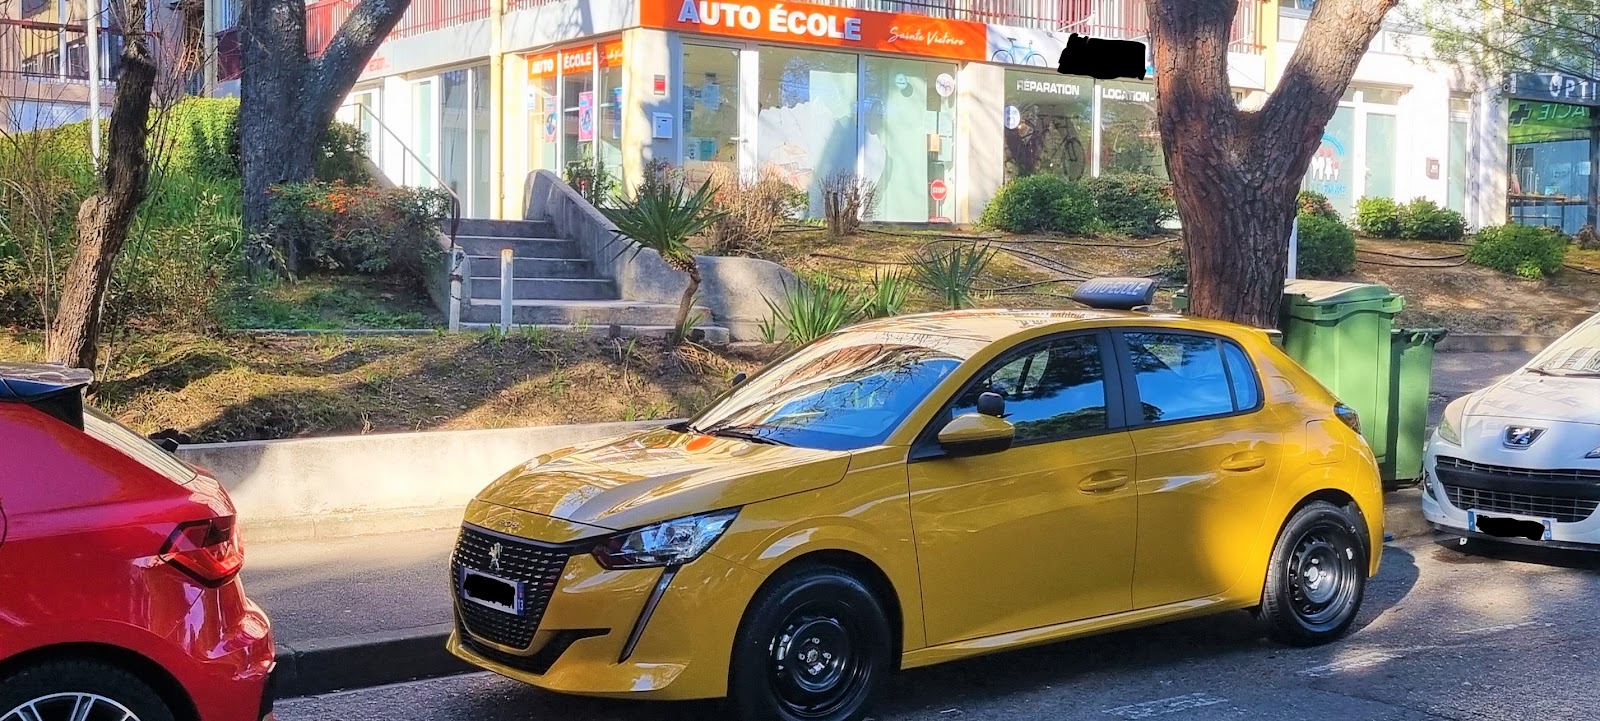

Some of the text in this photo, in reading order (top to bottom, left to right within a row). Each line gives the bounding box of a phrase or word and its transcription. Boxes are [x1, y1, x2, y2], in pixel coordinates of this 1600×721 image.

[678, 0, 861, 41] AUTO ÉCOLE
[888, 26, 965, 46] Sainte Victoire
[531, 58, 554, 75] AUTO
[563, 51, 592, 70] ÉCOLE
[1016, 79, 1080, 96] RÉPARATION
[1102, 87, 1150, 102] LOCATION
